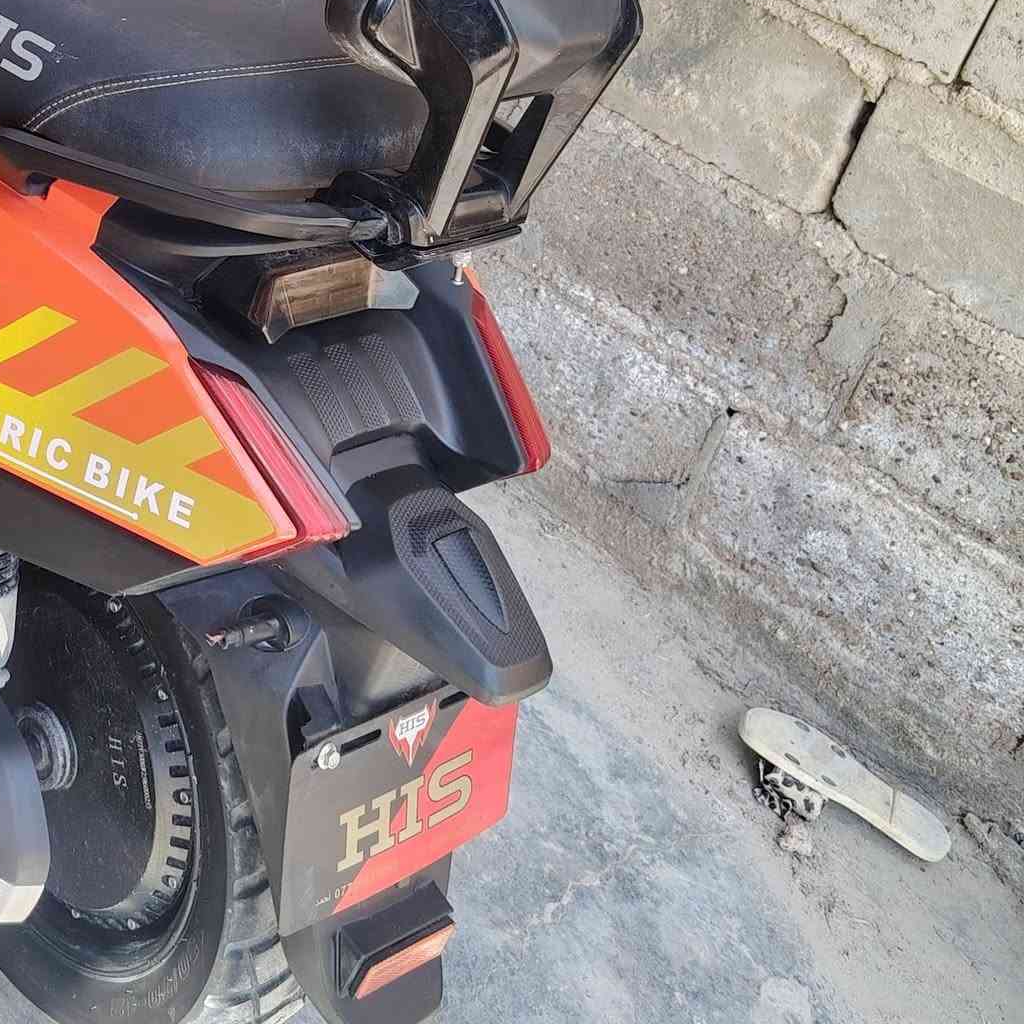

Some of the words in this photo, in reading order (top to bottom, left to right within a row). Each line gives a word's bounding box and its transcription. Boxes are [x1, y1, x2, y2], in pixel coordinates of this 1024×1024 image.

[83, 452, 195, 529] BIKE
[397, 711, 426, 736] HIS
[108, 736, 128, 789] HIS
[336, 748, 474, 873] HIS
